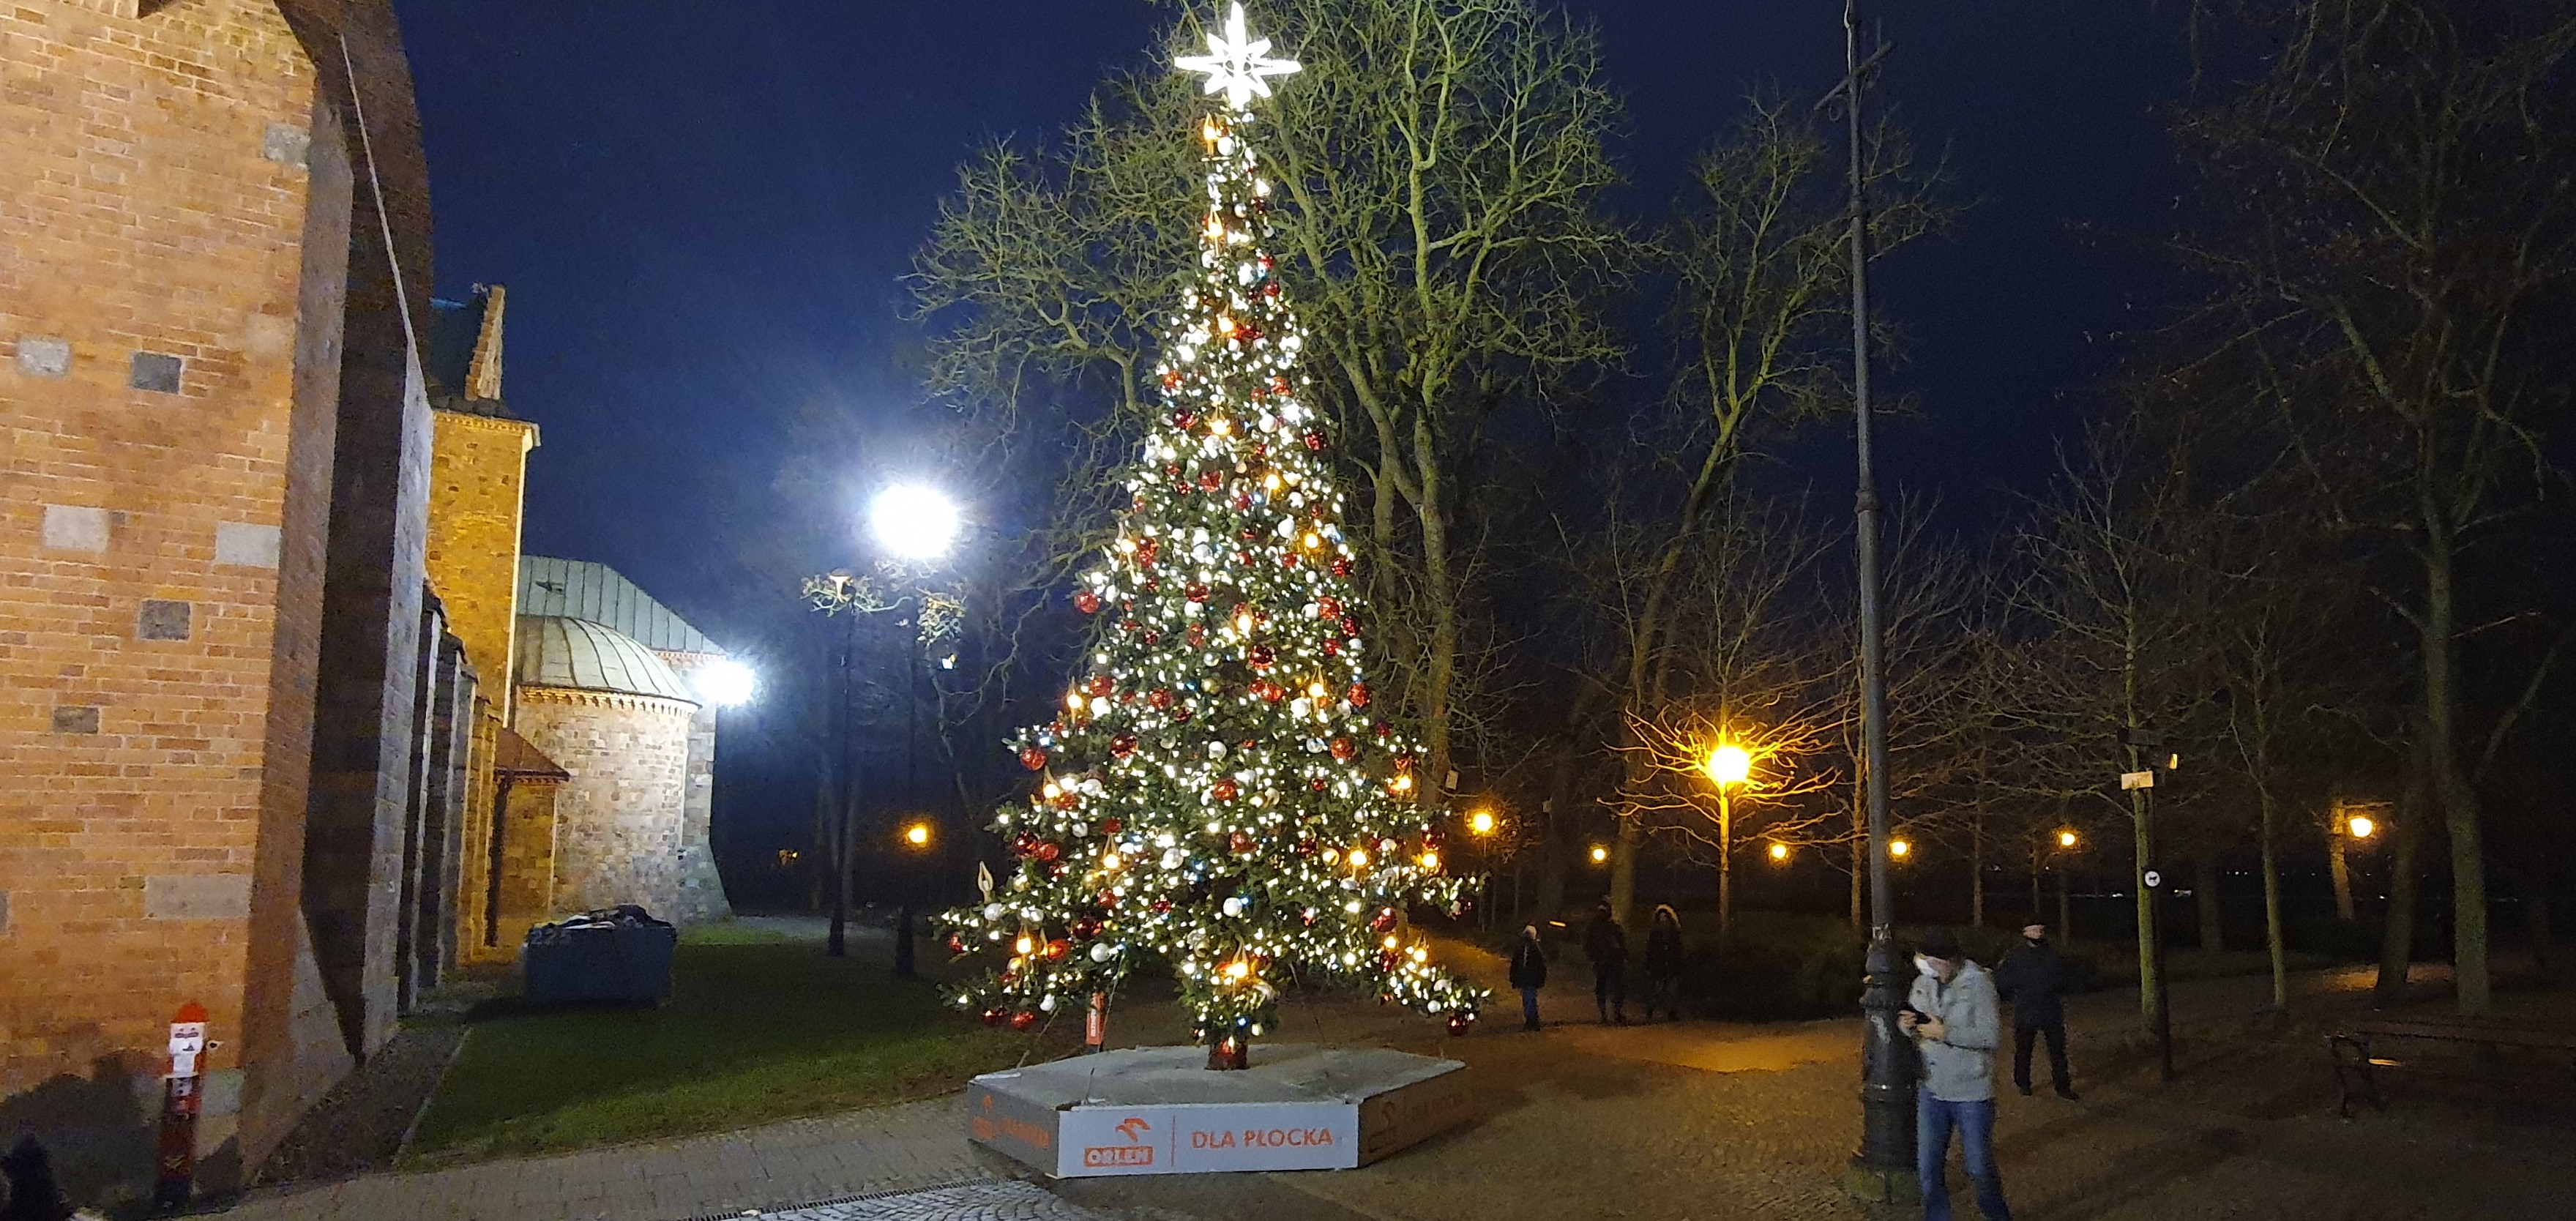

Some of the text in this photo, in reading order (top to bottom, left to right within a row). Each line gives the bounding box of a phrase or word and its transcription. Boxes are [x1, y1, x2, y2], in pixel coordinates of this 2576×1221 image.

[1192, 1127, 1333, 1149] DLA PŁOCKA
[1087, 1148, 1149, 1165] ORLEN
